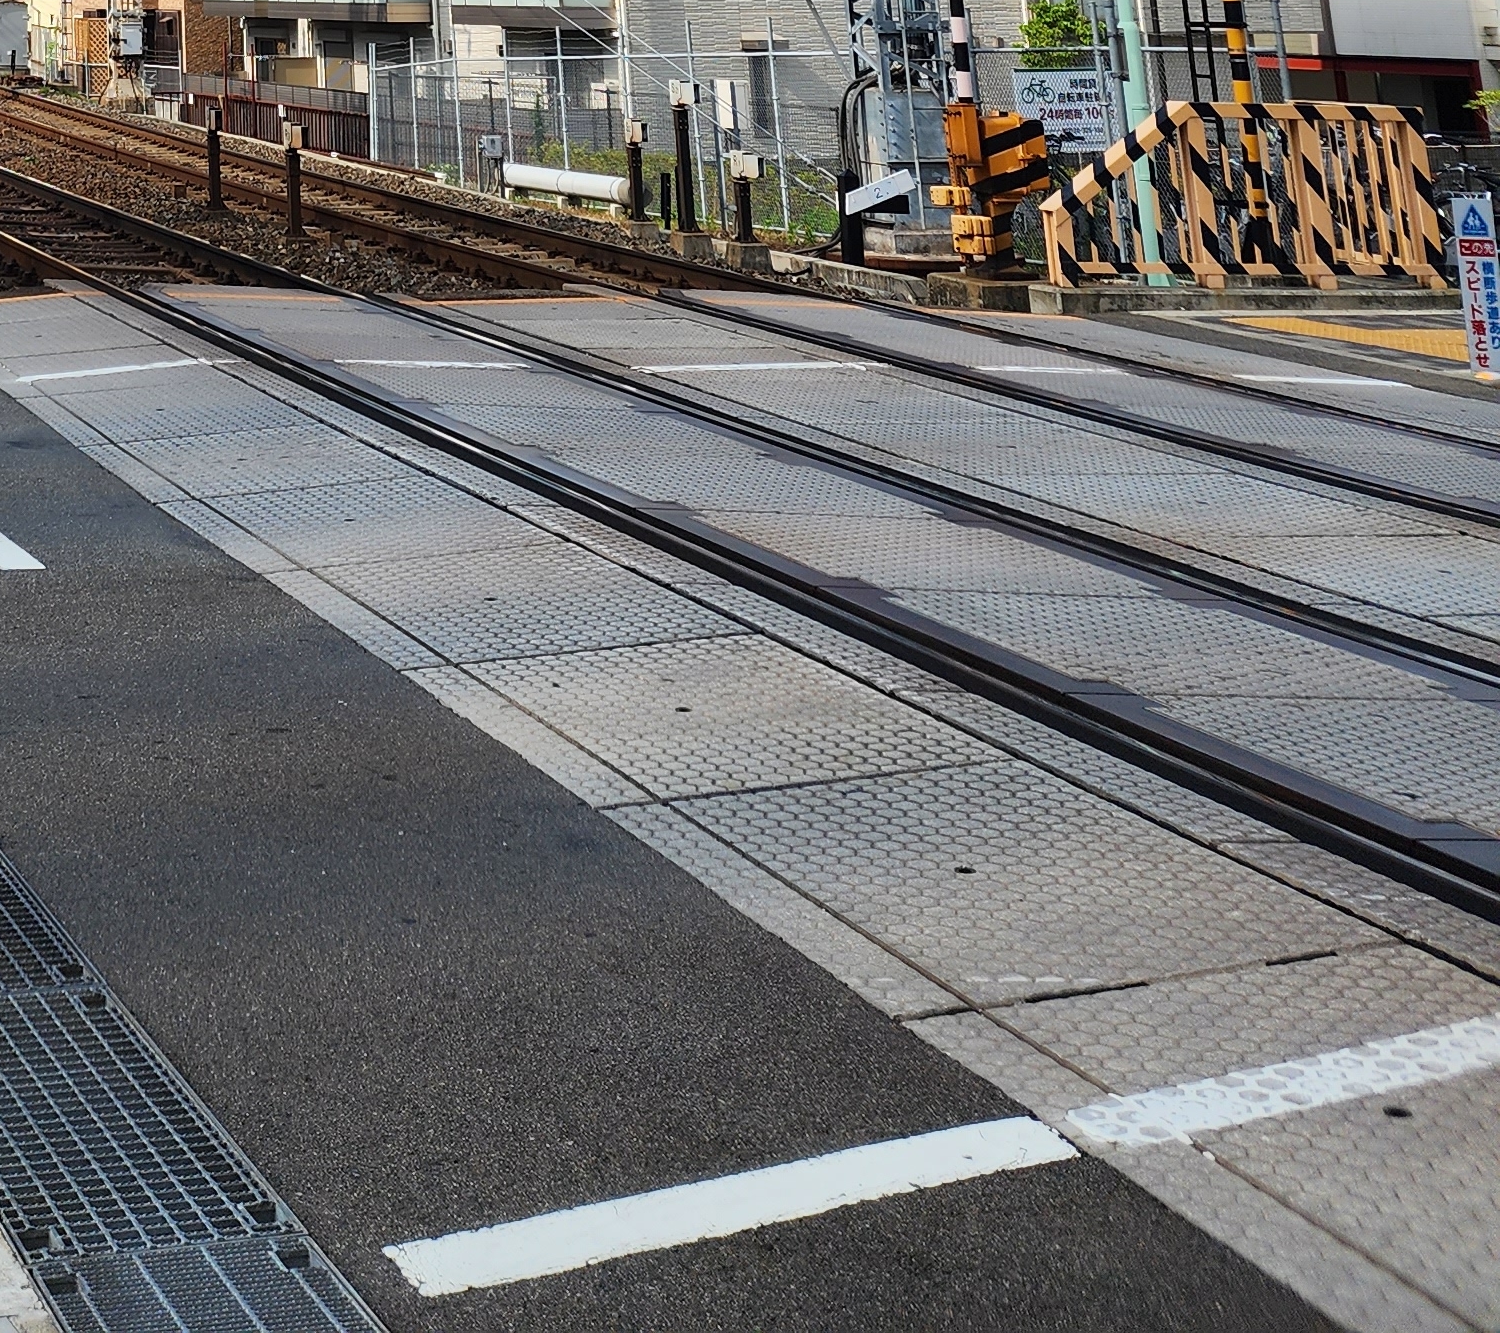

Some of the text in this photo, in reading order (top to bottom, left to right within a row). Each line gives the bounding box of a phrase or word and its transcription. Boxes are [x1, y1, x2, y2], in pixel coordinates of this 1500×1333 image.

[1460, 241, 1495, 254] この先
[1465, 260, 1490, 369] スピード落とせ
[1482, 260, 1500, 350] 横断歩道あり
